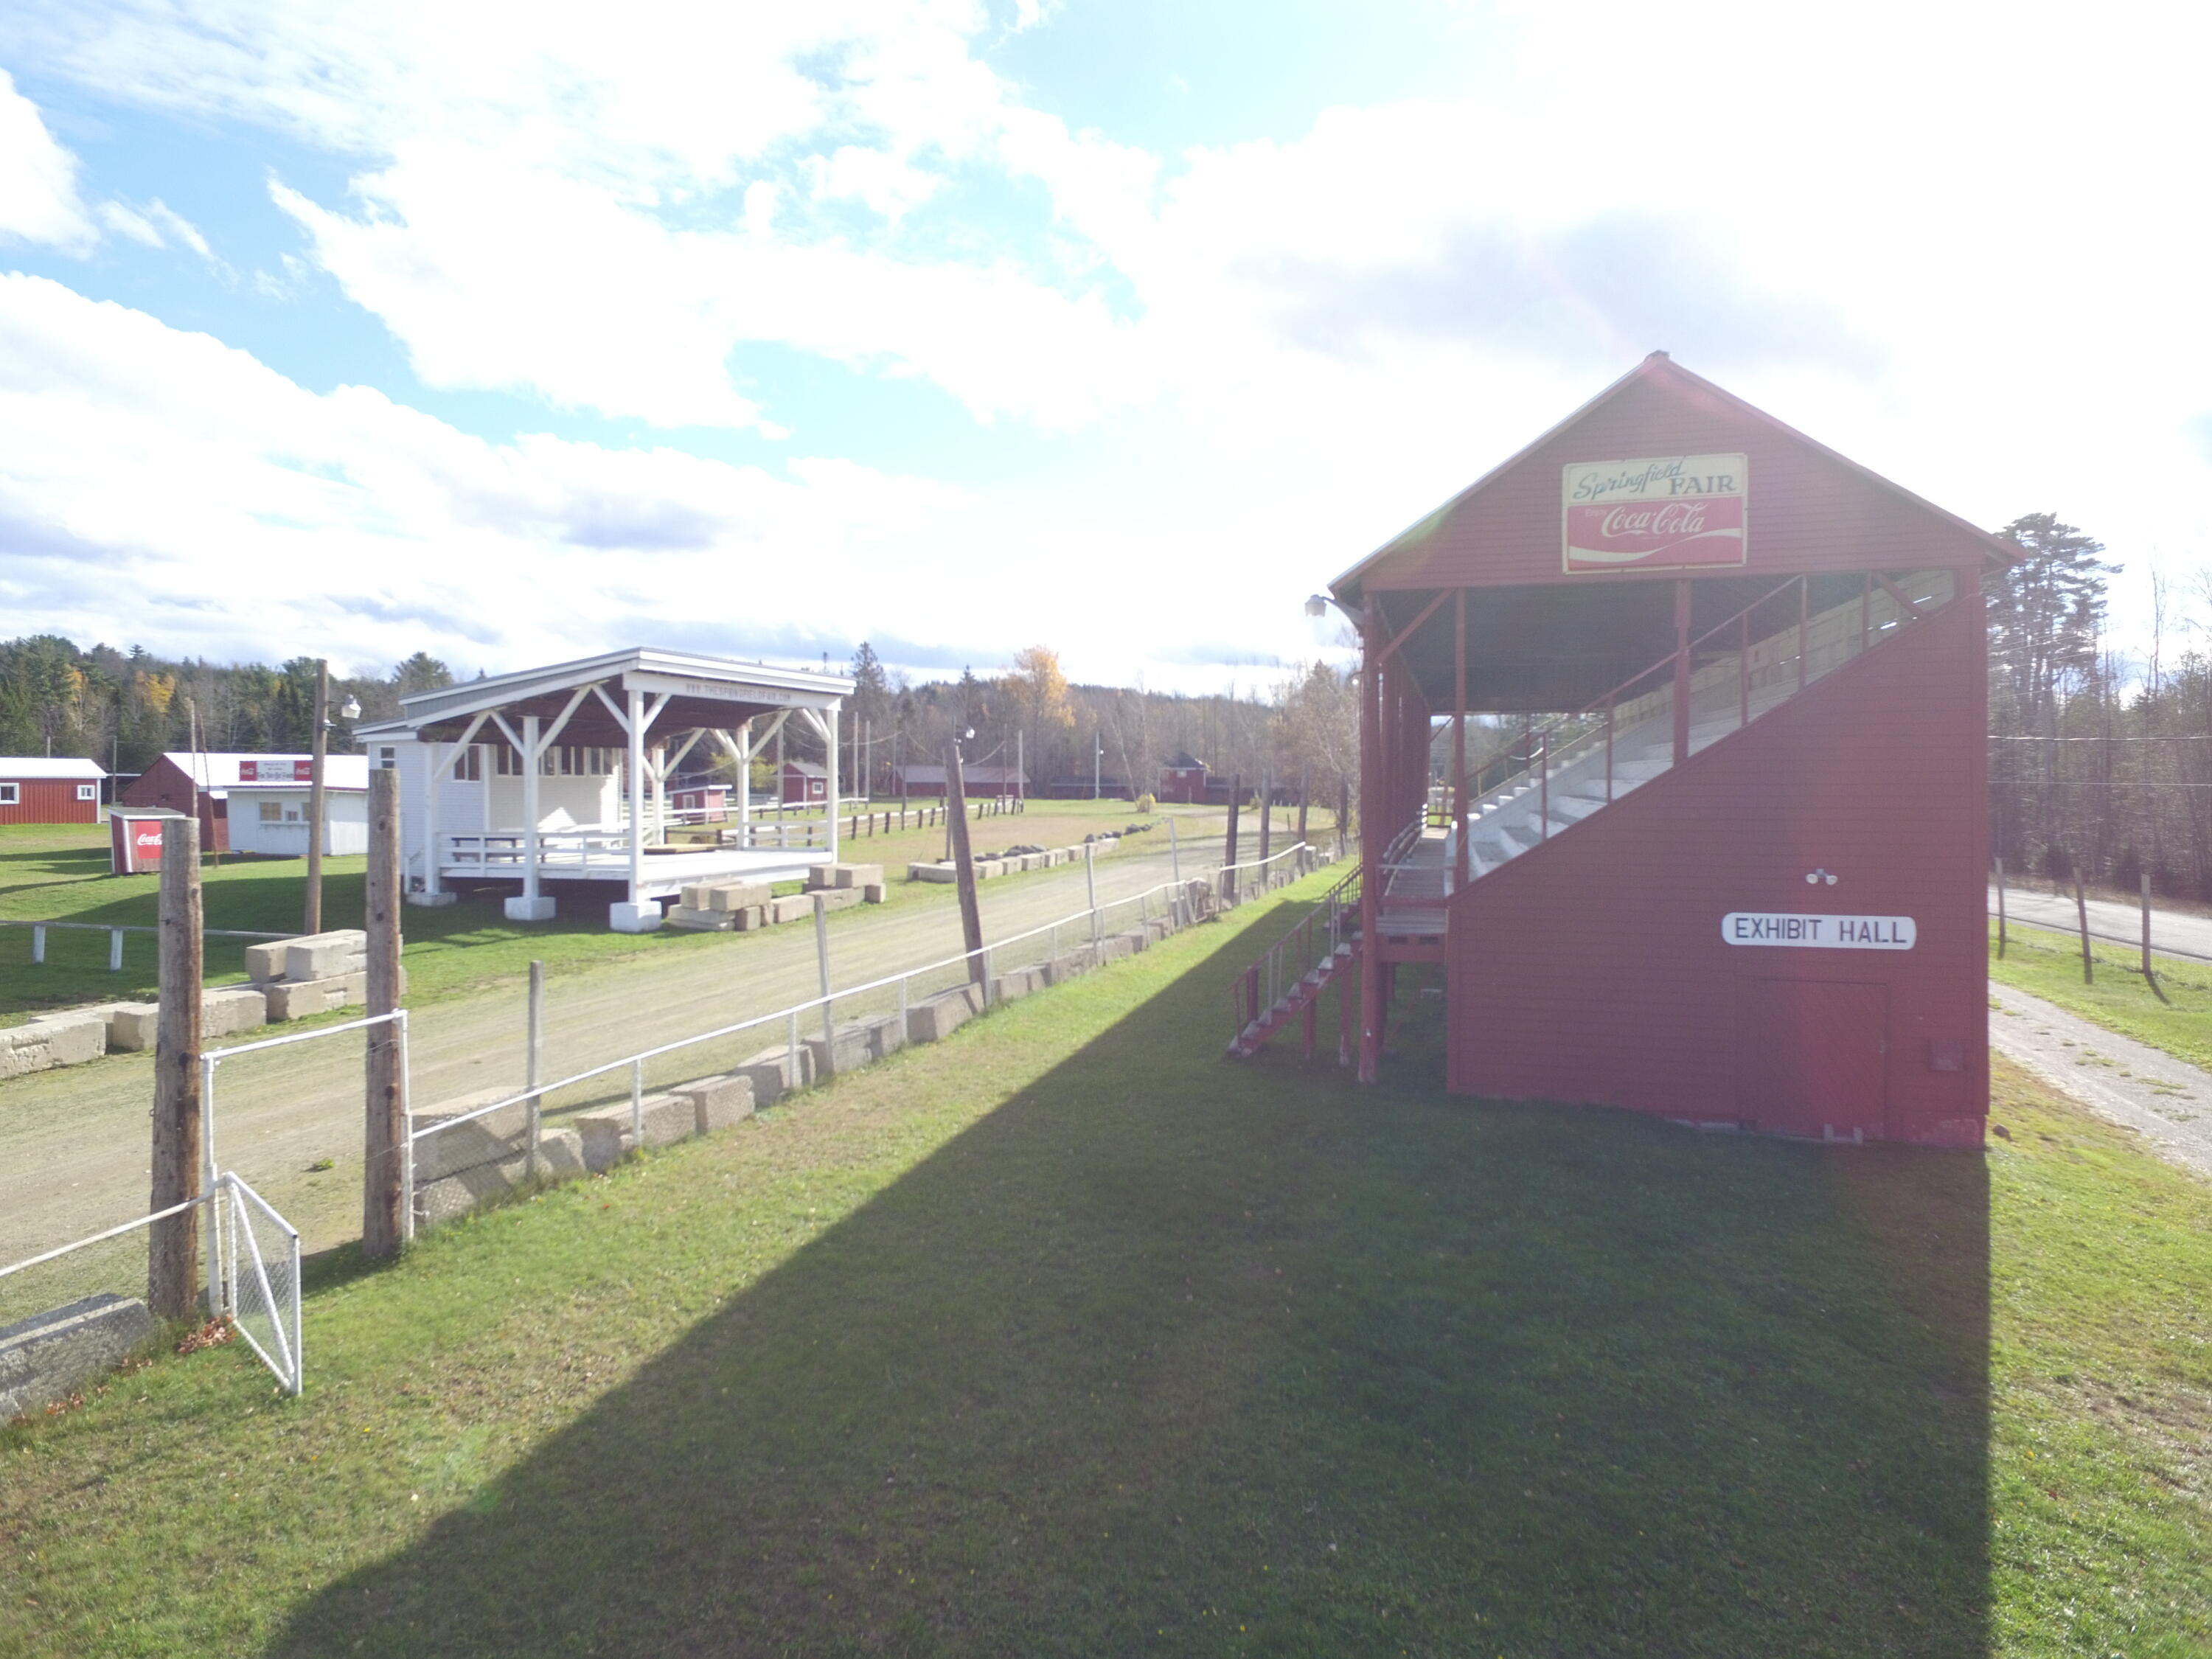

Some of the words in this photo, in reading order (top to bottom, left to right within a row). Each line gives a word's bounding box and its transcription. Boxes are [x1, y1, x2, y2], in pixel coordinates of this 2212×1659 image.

[1573, 462, 1685, 499] Springfield
[1669, 475, 1736, 494] FAIR
[1601, 502, 1708, 538] Coca-Cola
[137, 833, 162, 846] Coca-C
[1735, 917, 1822, 939] EXHIBIT
[1840, 920, 1907, 943] HALL
